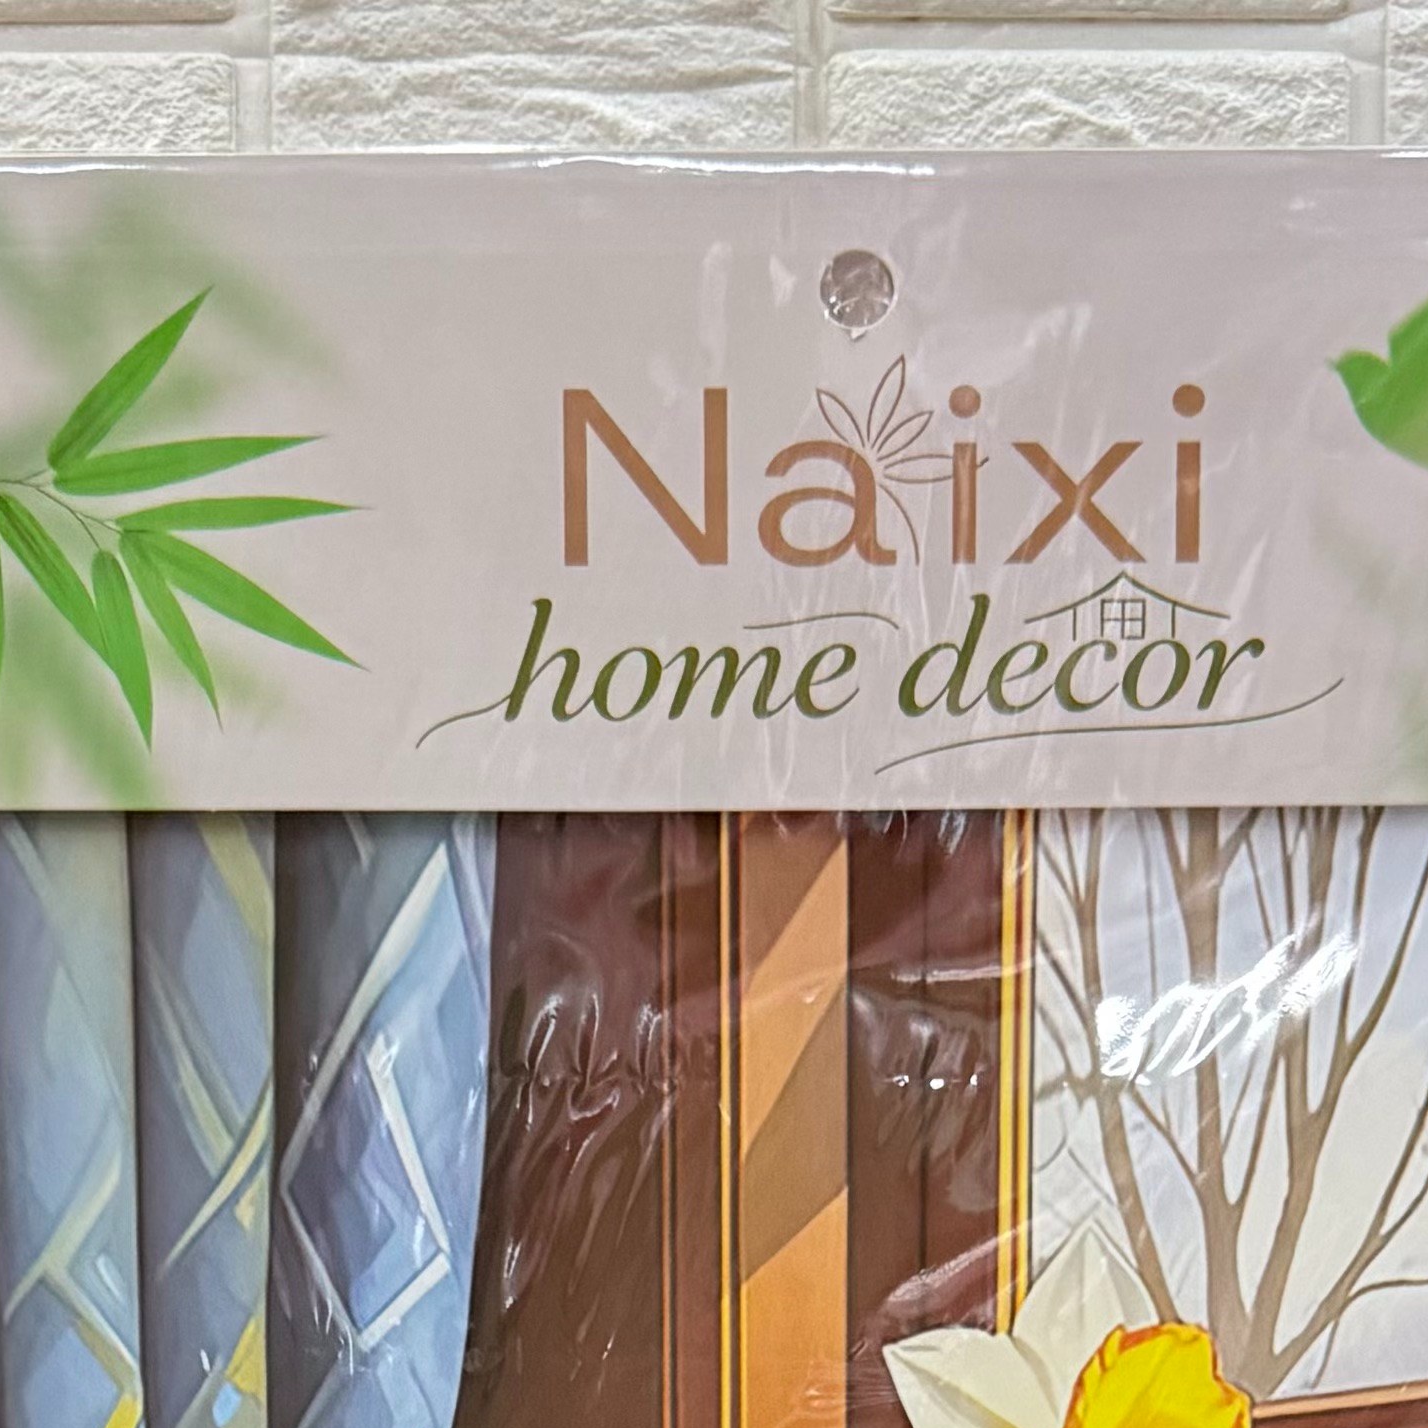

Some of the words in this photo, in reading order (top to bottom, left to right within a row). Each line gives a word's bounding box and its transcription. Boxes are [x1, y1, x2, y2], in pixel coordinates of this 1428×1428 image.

[562, 383, 1206, 567] Naixi
[505, 597, 860, 723] home
[897, 593, 1265, 718] decor
